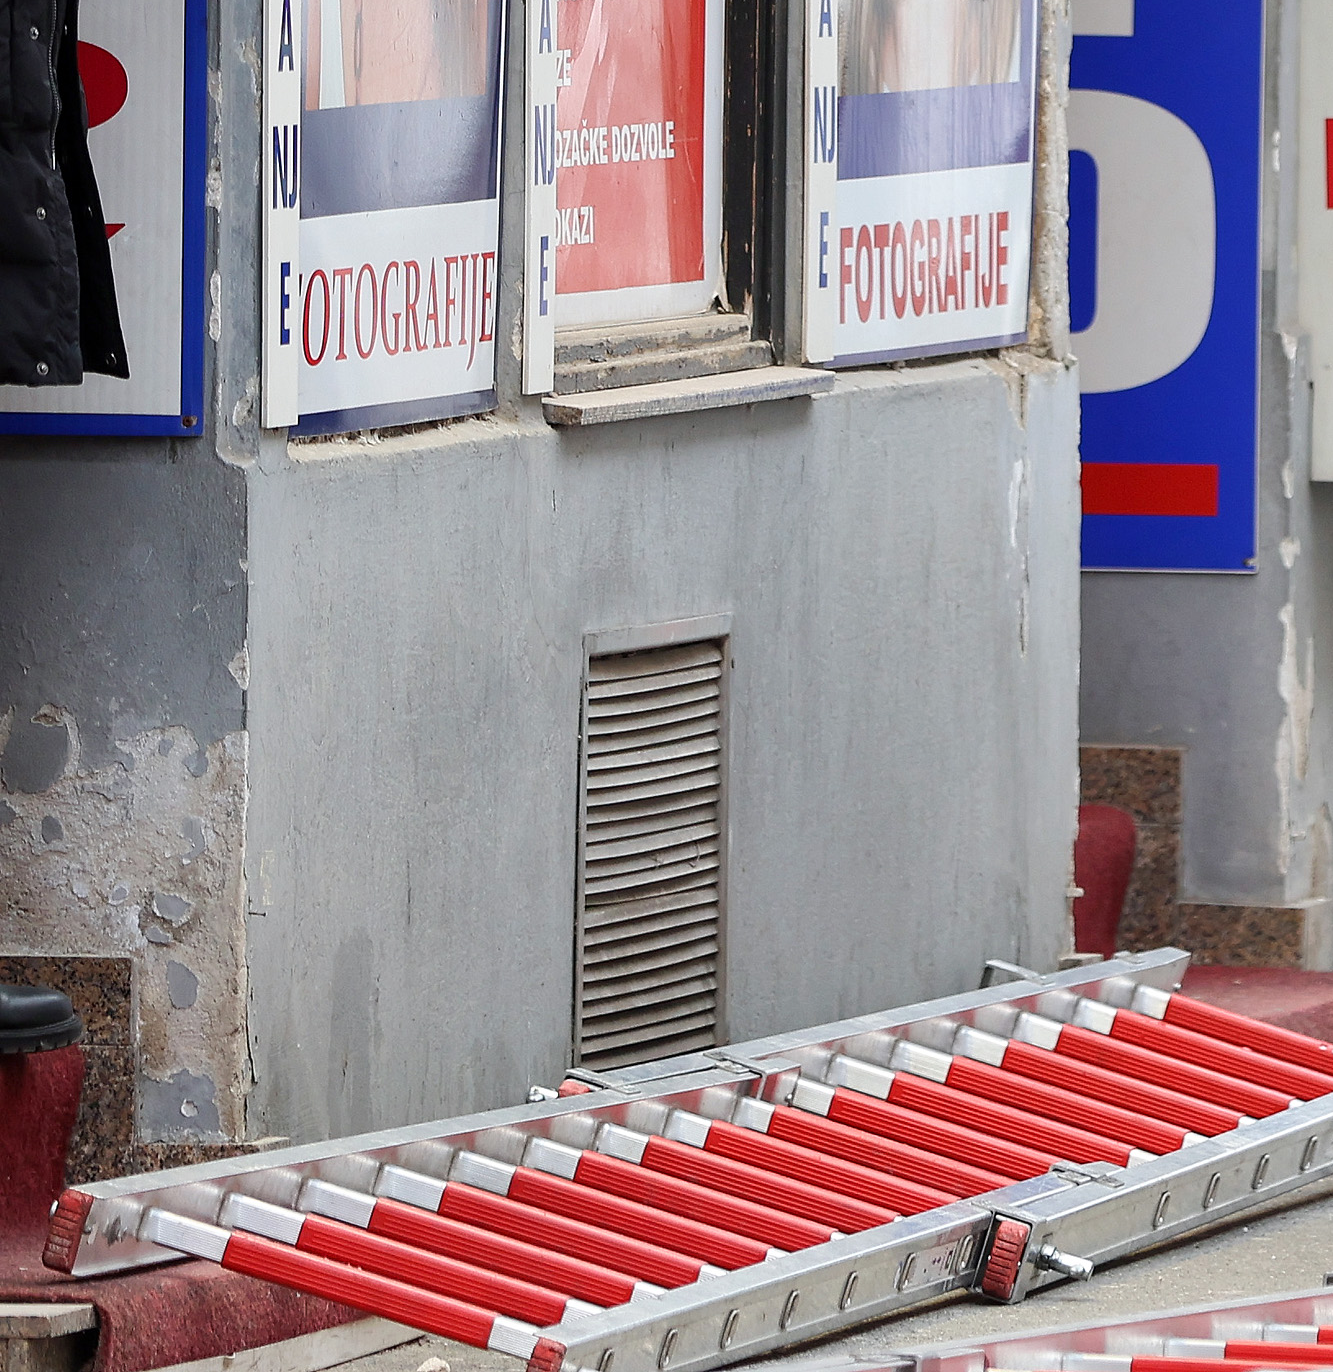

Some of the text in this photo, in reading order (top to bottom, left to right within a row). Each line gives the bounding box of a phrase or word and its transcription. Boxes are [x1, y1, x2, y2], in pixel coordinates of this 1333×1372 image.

[611, 120, 676, 164] DOZVOLE
[299, 251, 497, 372] OTOGRAFIJE
[839, 210, 1010, 325] FOTOGRAFIJE
